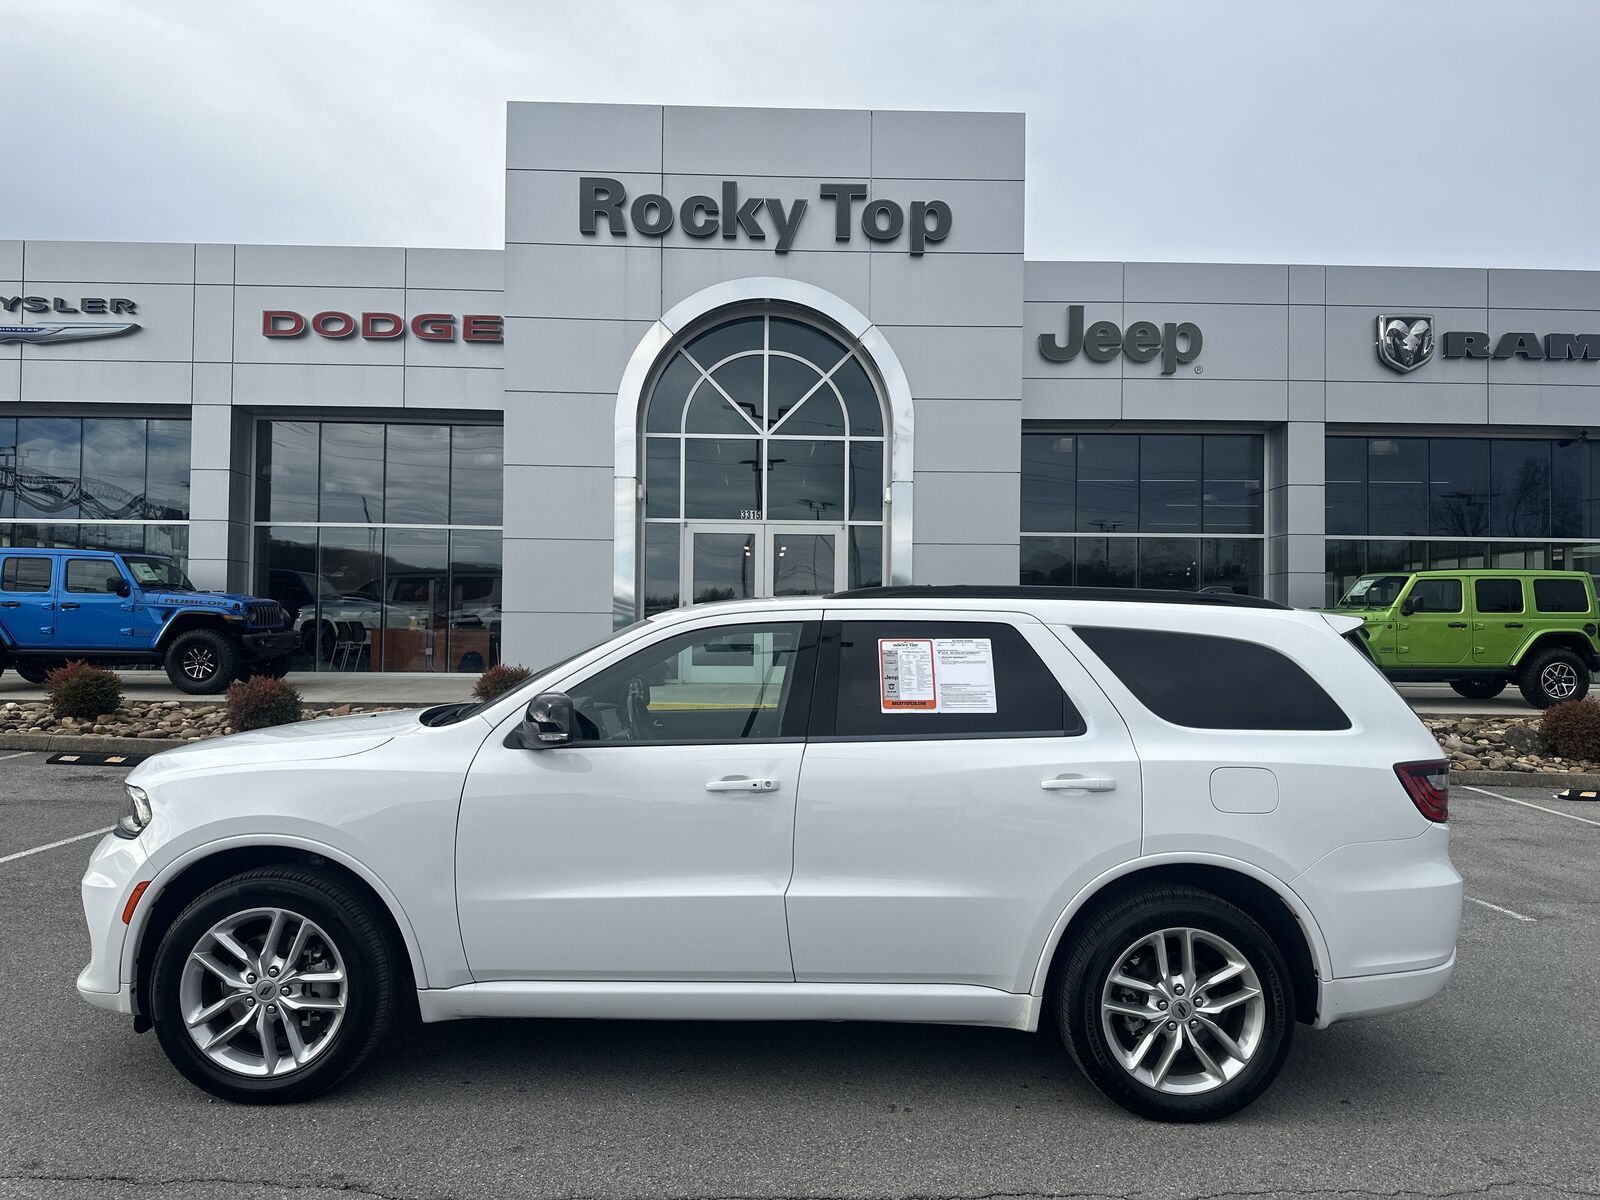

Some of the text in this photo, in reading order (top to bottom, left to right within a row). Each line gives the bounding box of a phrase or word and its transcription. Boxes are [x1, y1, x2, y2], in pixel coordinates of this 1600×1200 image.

[579, 176, 953, 256] Rocky Top
[262, 310, 504, 345] DODGE
[1038, 305, 1204, 376] Jeep
[1443, 331, 1600, 361] RAM
[741, 510, 761, 520] 3315
[164, 598, 228, 607] RUBICON
